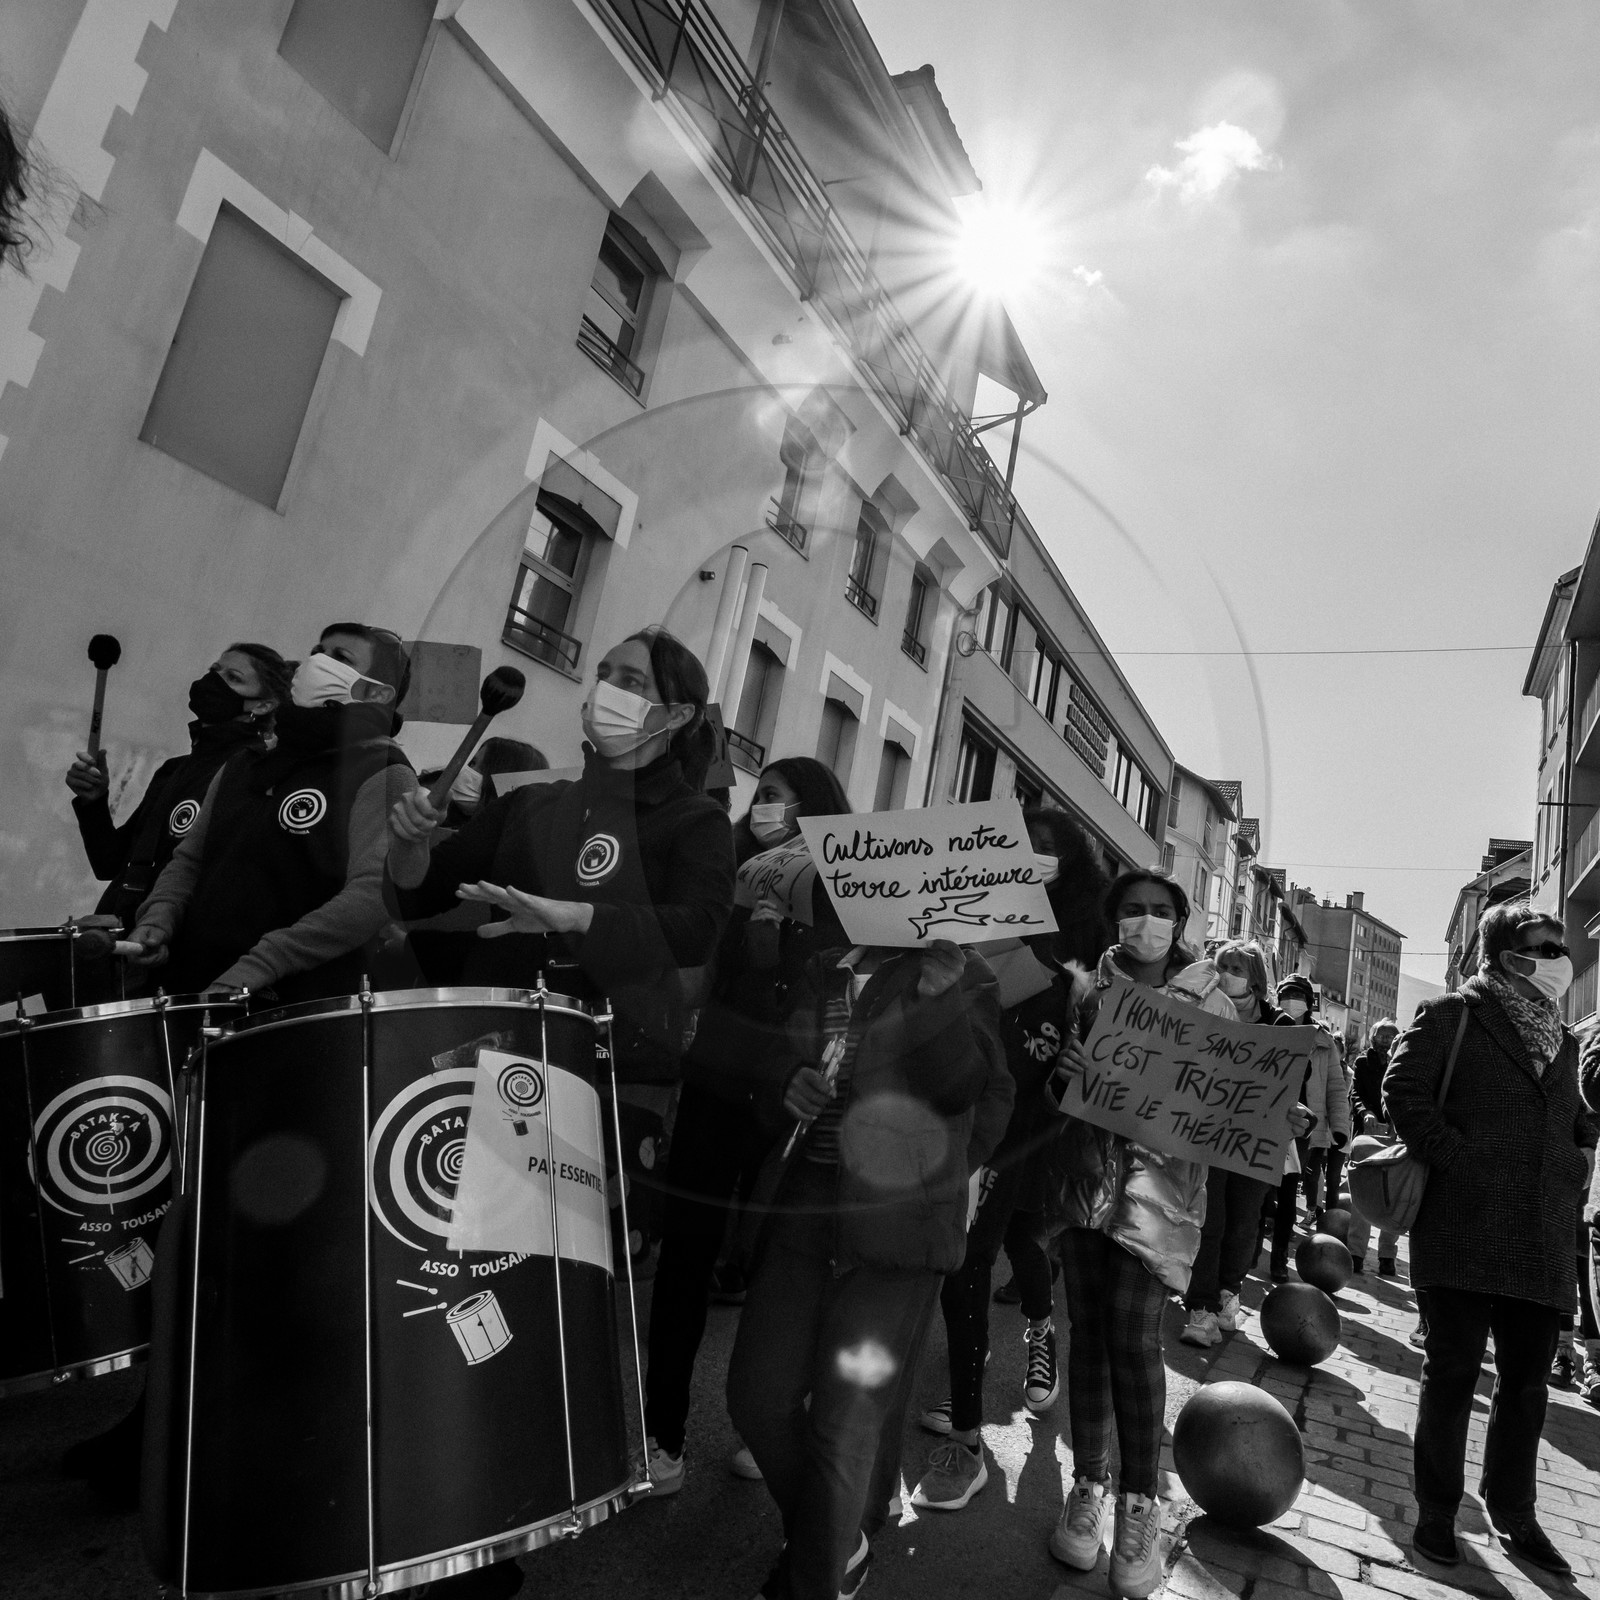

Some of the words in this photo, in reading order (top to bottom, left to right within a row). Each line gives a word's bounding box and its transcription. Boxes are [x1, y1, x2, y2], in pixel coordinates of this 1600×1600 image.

[822, 830, 934, 864] Cultivons
[948, 824, 1019, 852] notre
[826, 869, 911, 899] terre
[918, 865, 1044, 894] intérieure
[1091, 1031, 1163, 1076] C'EST
[1198, 1032, 1257, 1065] SANS
[1250, 1046, 1308, 1080] ART
[420, 1116, 467, 1145] BATA
[1135, 1094, 1163, 1120] LE
[1170, 1111, 1279, 1171] THÉÂTRE
[560, 1163, 604, 1194] ESSENTIE
[979, 1165, 999, 1190] KE
[79, 1222, 112, 1232] ASSO
[121, 1200, 173, 1230] TOUSAM
[420, 1259, 459, 1277] ASSO
[469, 1253, 532, 1278] TOUSAM
